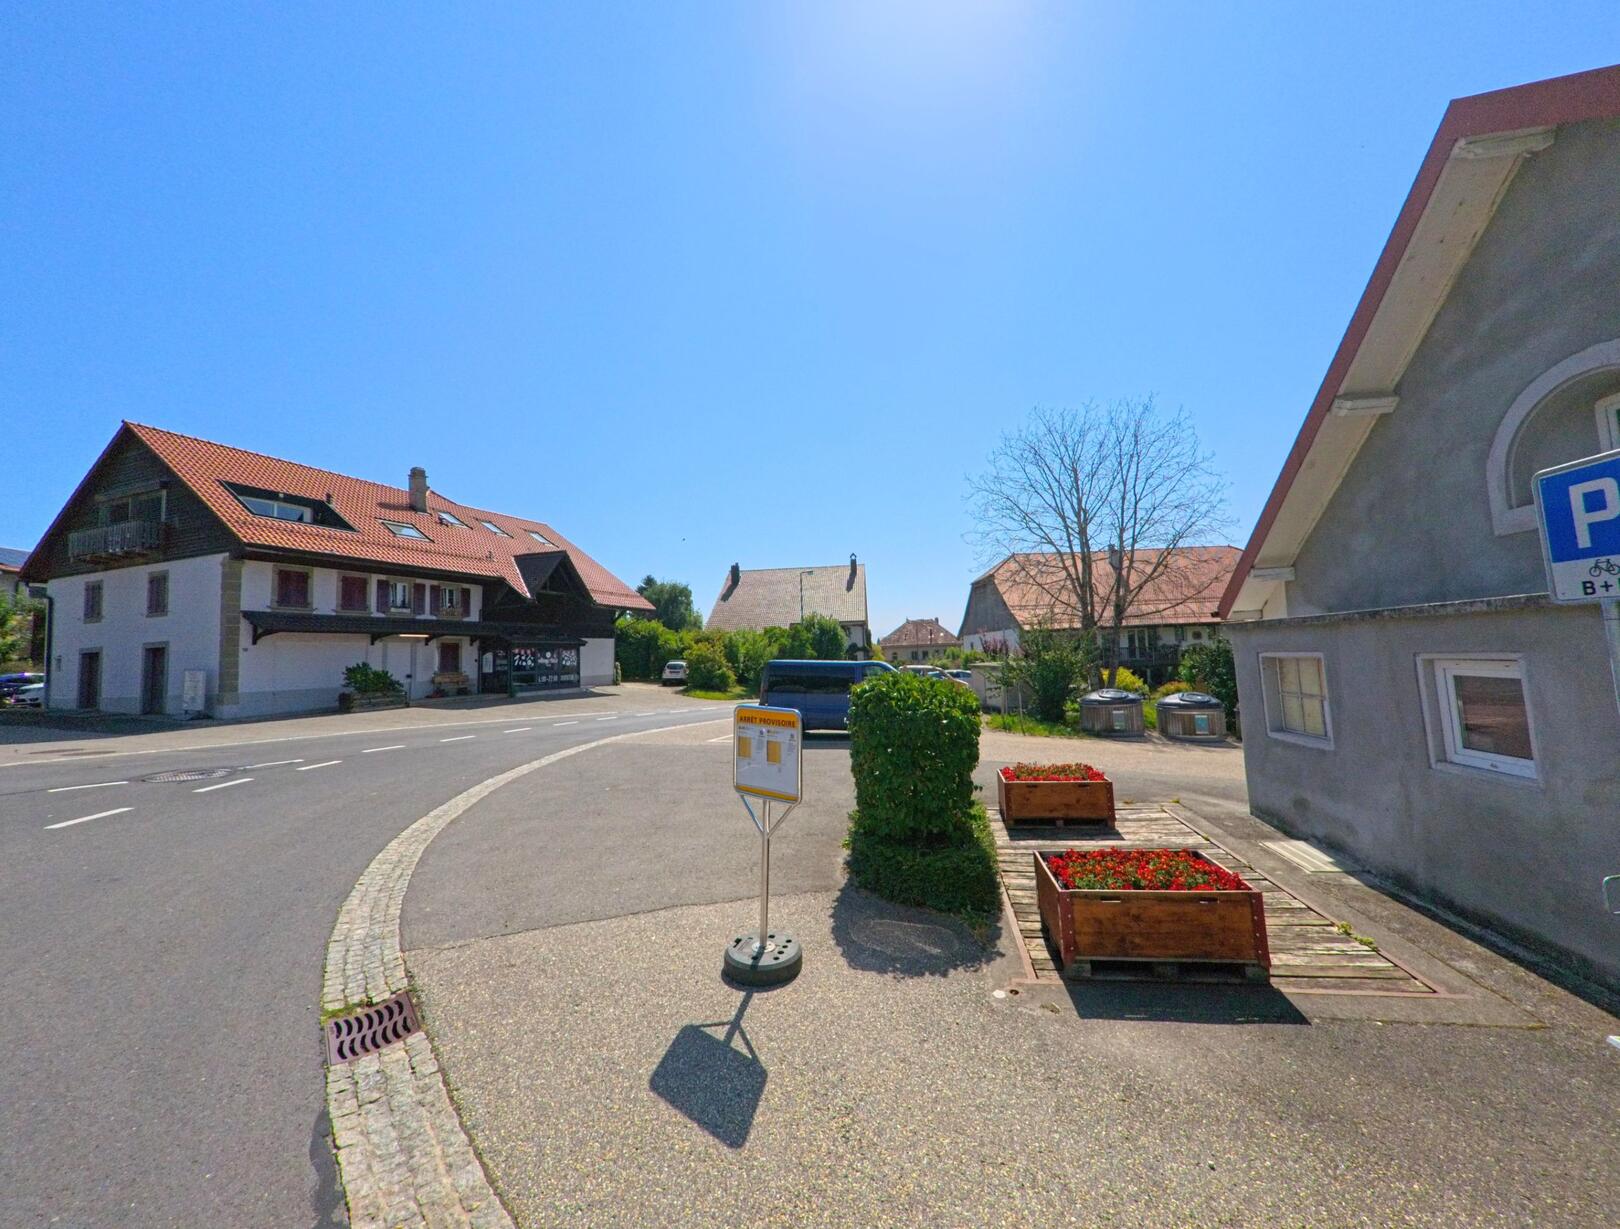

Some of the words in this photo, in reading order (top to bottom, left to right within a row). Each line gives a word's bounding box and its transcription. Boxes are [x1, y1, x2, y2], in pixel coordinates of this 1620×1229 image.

[1568, 476, 1620, 549] P
[1582, 577, 1620, 595] B+
[759, 717, 796, 728] PROVISOIRE
